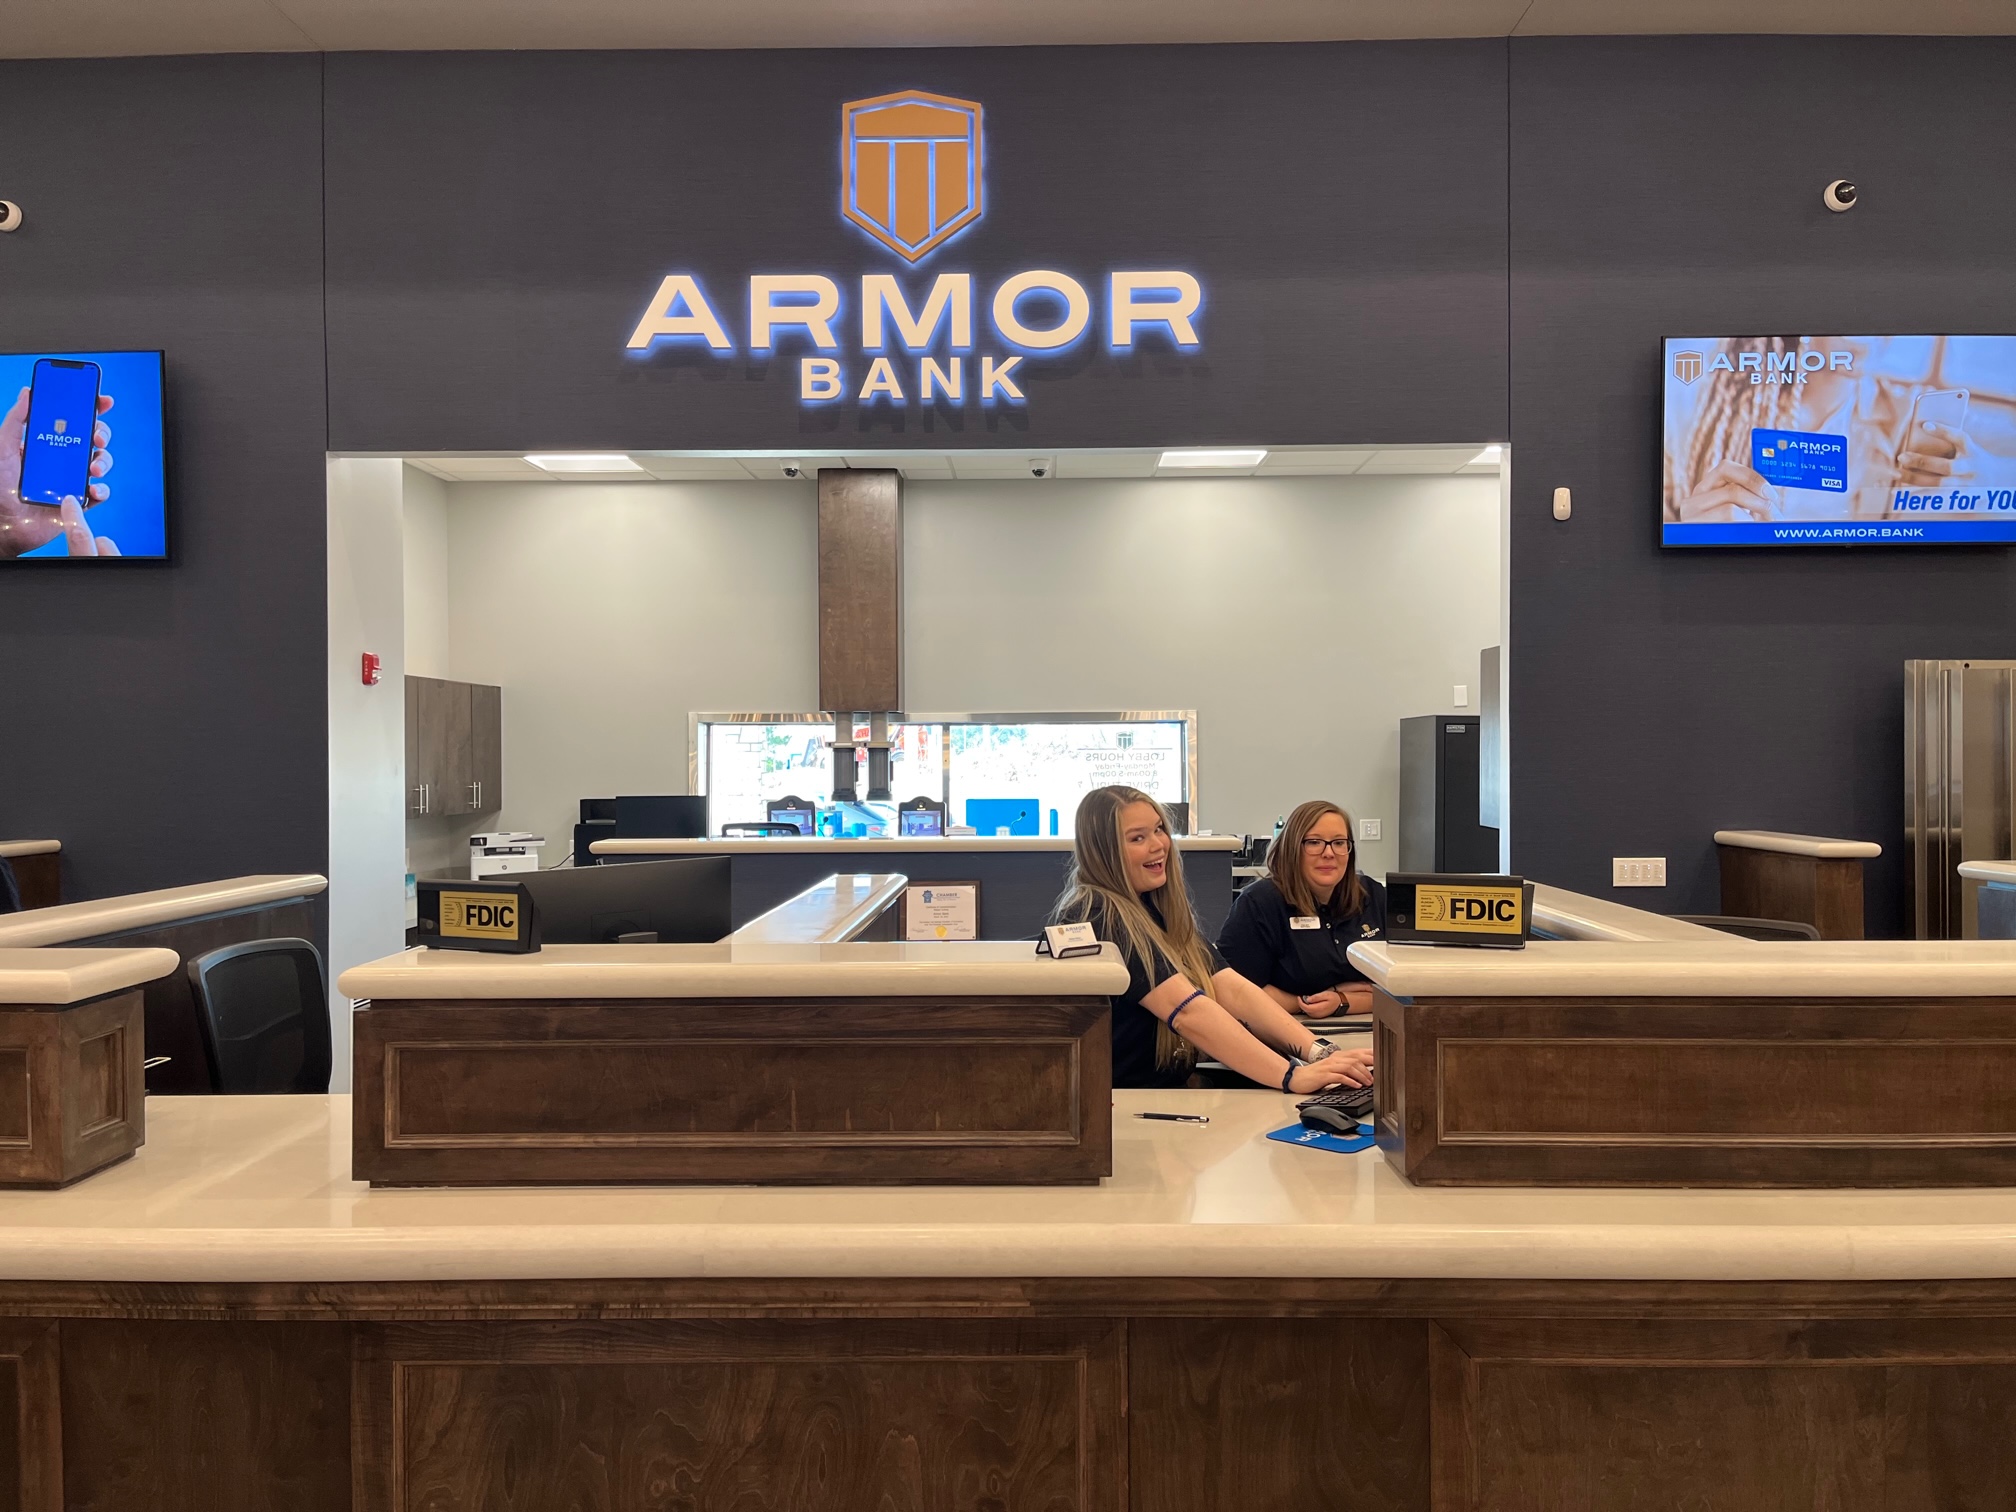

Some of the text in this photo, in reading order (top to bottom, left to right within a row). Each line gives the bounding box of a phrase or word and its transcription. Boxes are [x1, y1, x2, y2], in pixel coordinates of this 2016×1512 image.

[626, 269, 1202, 350] ARMOR
[1708, 350, 1854, 373] ARMOR
[800, 356, 1025, 401] BANK
[1750, 372, 1808, 385] BANK
[37, 433, 81, 444] ARMOR
[1789, 441, 1841, 453] ARMOR
[1823, 479, 1841, 487] VISA
[1893, 490, 1943, 511] Here
[1949, 490, 1980, 511] for
[1774, 527, 1924, 539] WWW.ARMOR.BANK
[466, 904, 514, 928] FDIC
[1450, 898, 1515, 922] FDIC
